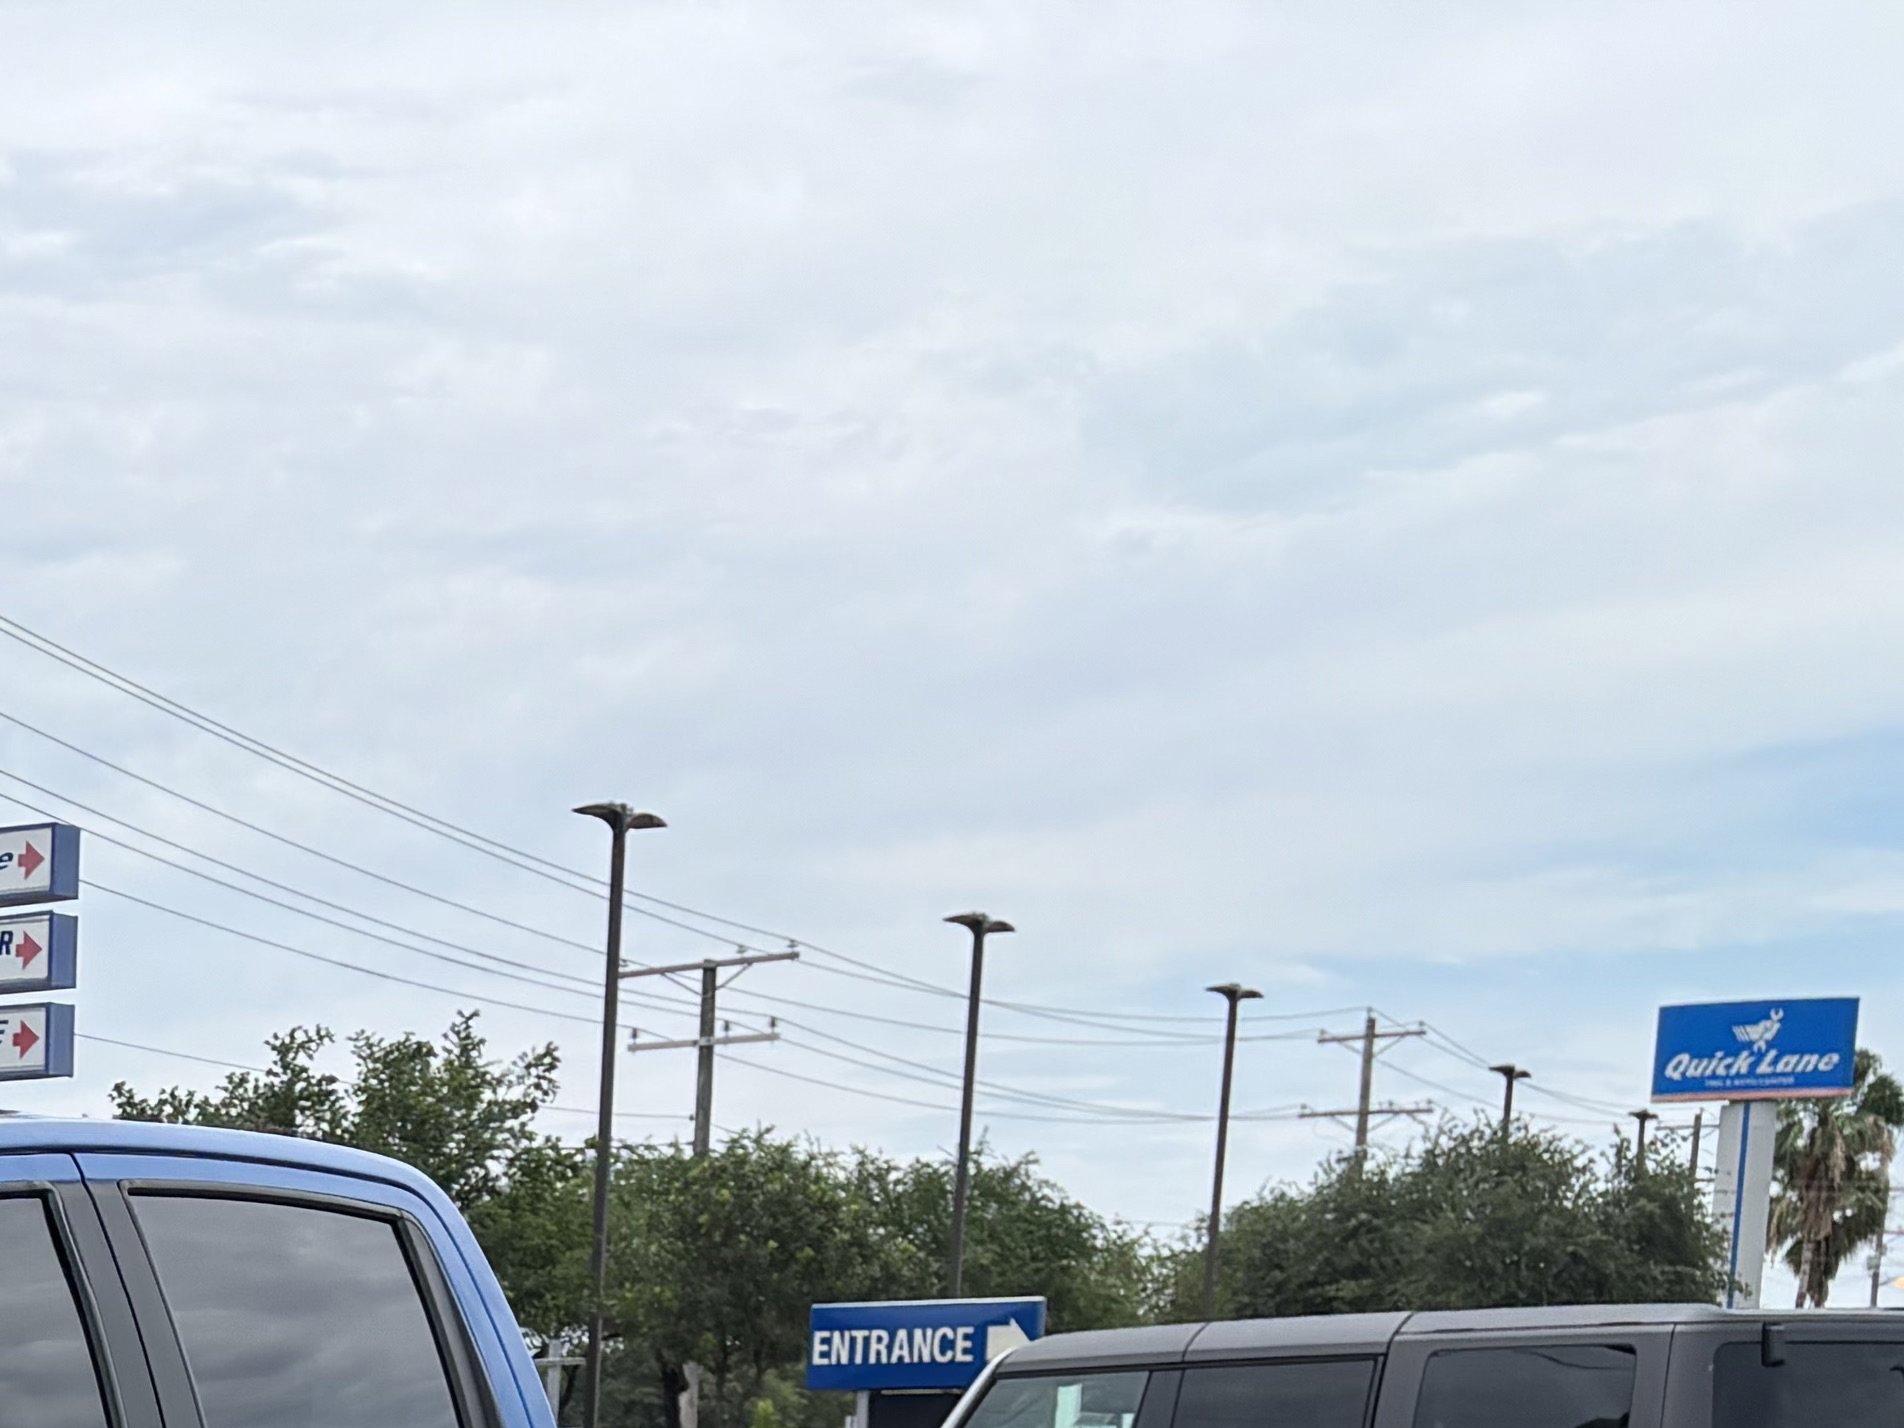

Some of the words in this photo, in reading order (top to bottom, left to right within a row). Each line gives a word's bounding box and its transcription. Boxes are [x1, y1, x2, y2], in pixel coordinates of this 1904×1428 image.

[1664, 1051, 1756, 1081] Quick
[1756, 1049, 1840, 1075] Lane
[812, 1327, 974, 1366] ENTRANCE
